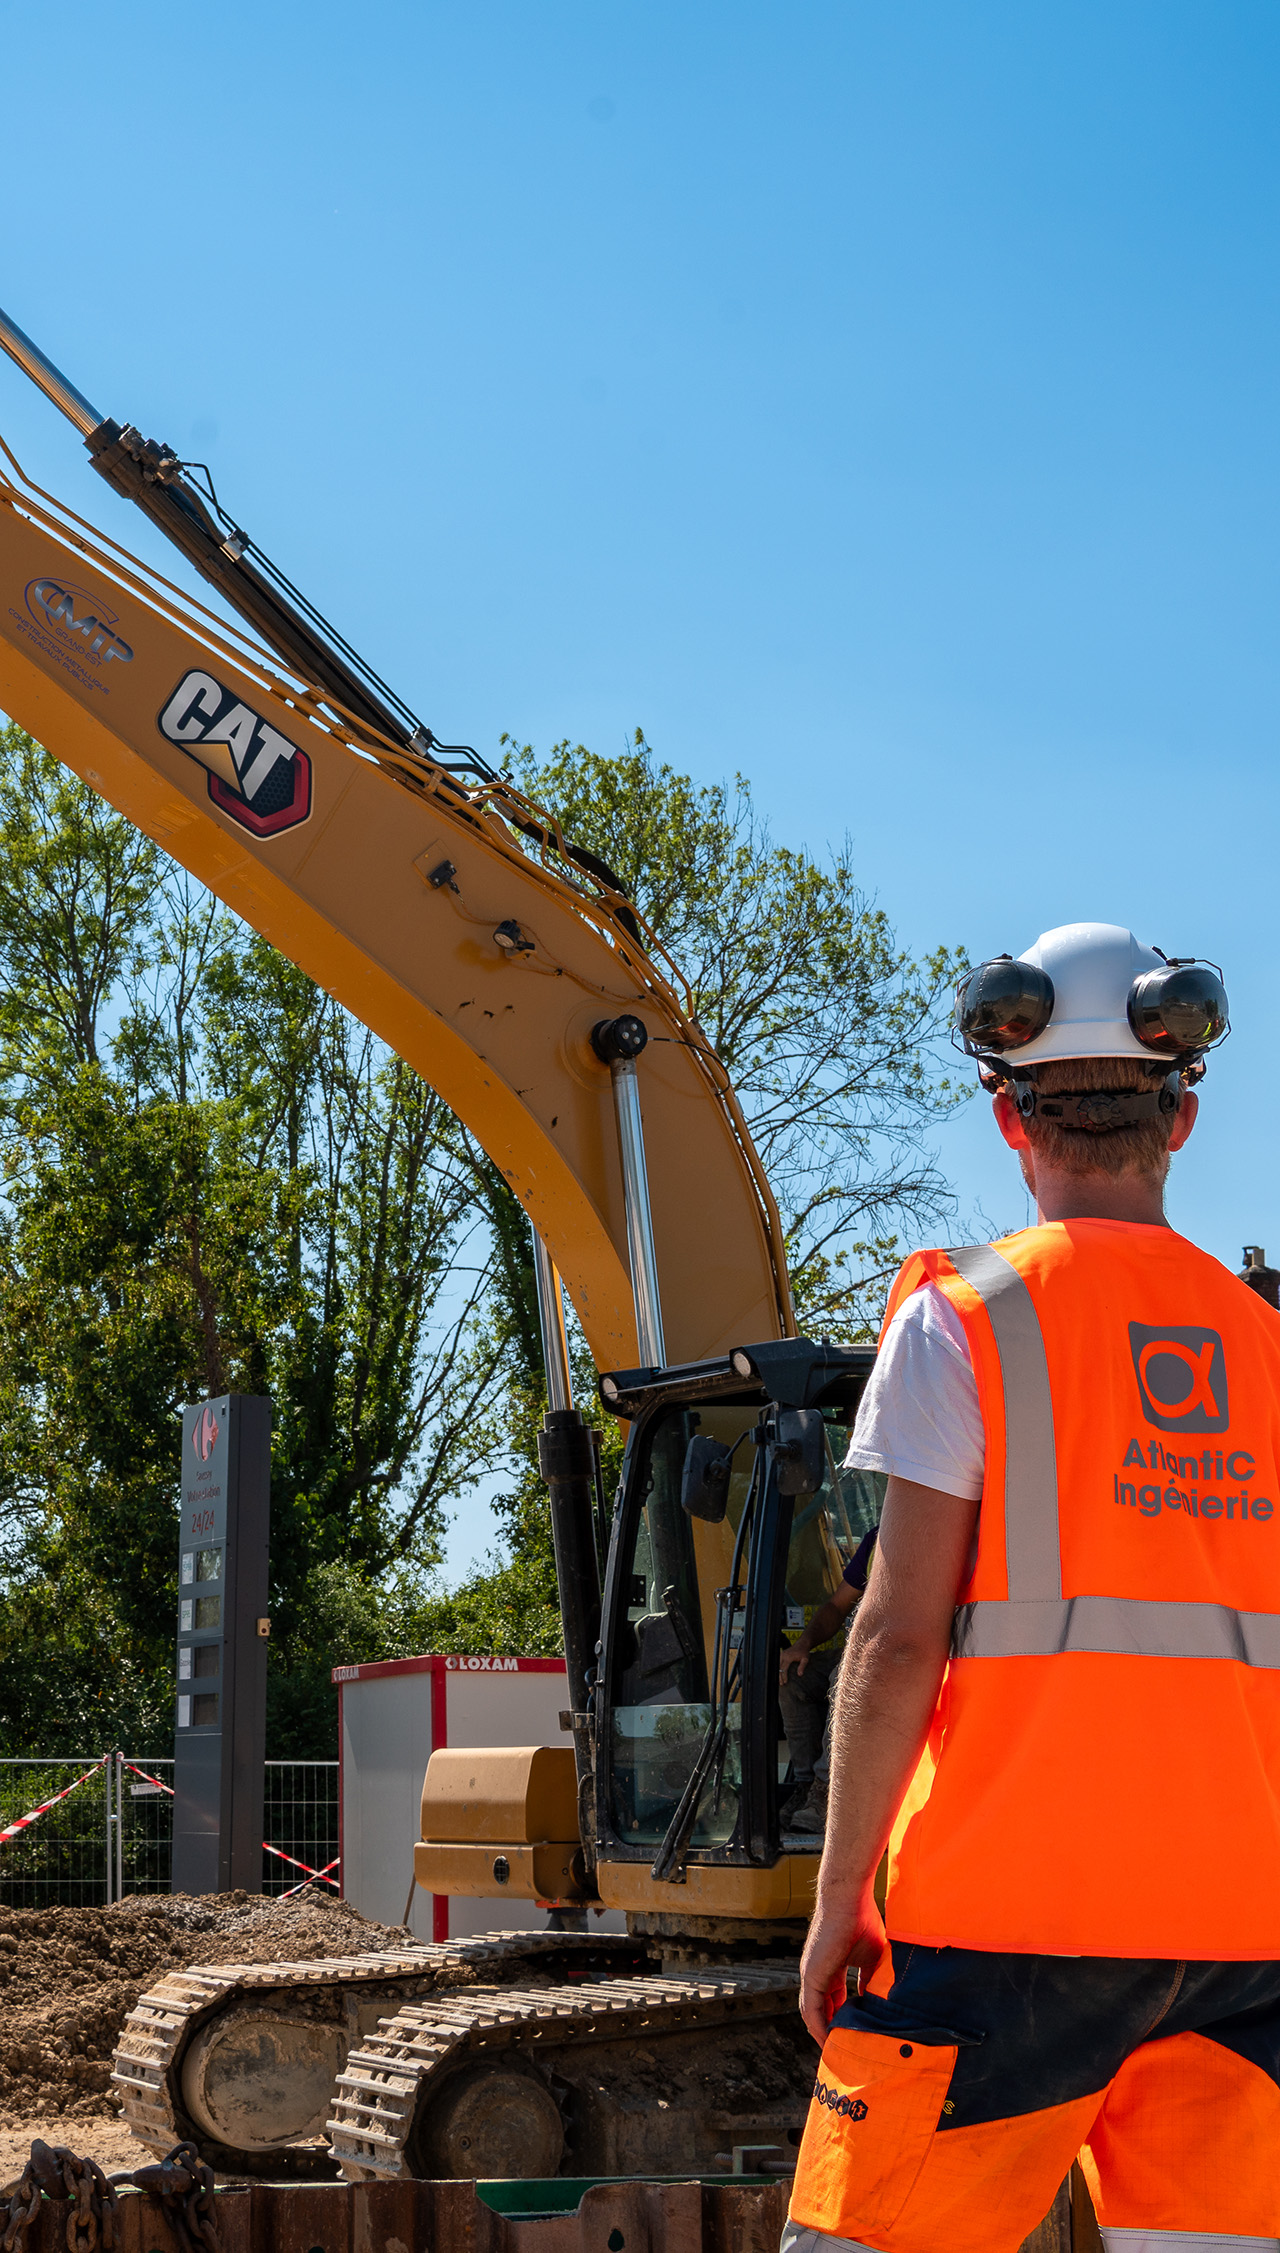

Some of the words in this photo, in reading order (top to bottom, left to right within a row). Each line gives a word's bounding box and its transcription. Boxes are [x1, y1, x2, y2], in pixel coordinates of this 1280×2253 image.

[34, 580, 134, 663] CMTP
[8, 608, 65, 657] CONSTRUCTION
[64, 656, 110, 695] METALLIQUE
[16, 624, 27, 634] ET
[27, 632, 62, 664] TRAVAUX
[62, 662, 94, 691] PUBLICS
[161, 671, 297, 801] CAT
[1122, 1438, 1256, 1481] AtlantiC
[1113, 1473, 1274, 1521] Ingénierie
[192, 1509, 215, 1536] 24/24
[338, 1667, 360, 1681] LOXAM
[459, 1657, 519, 1671] LOXAM
